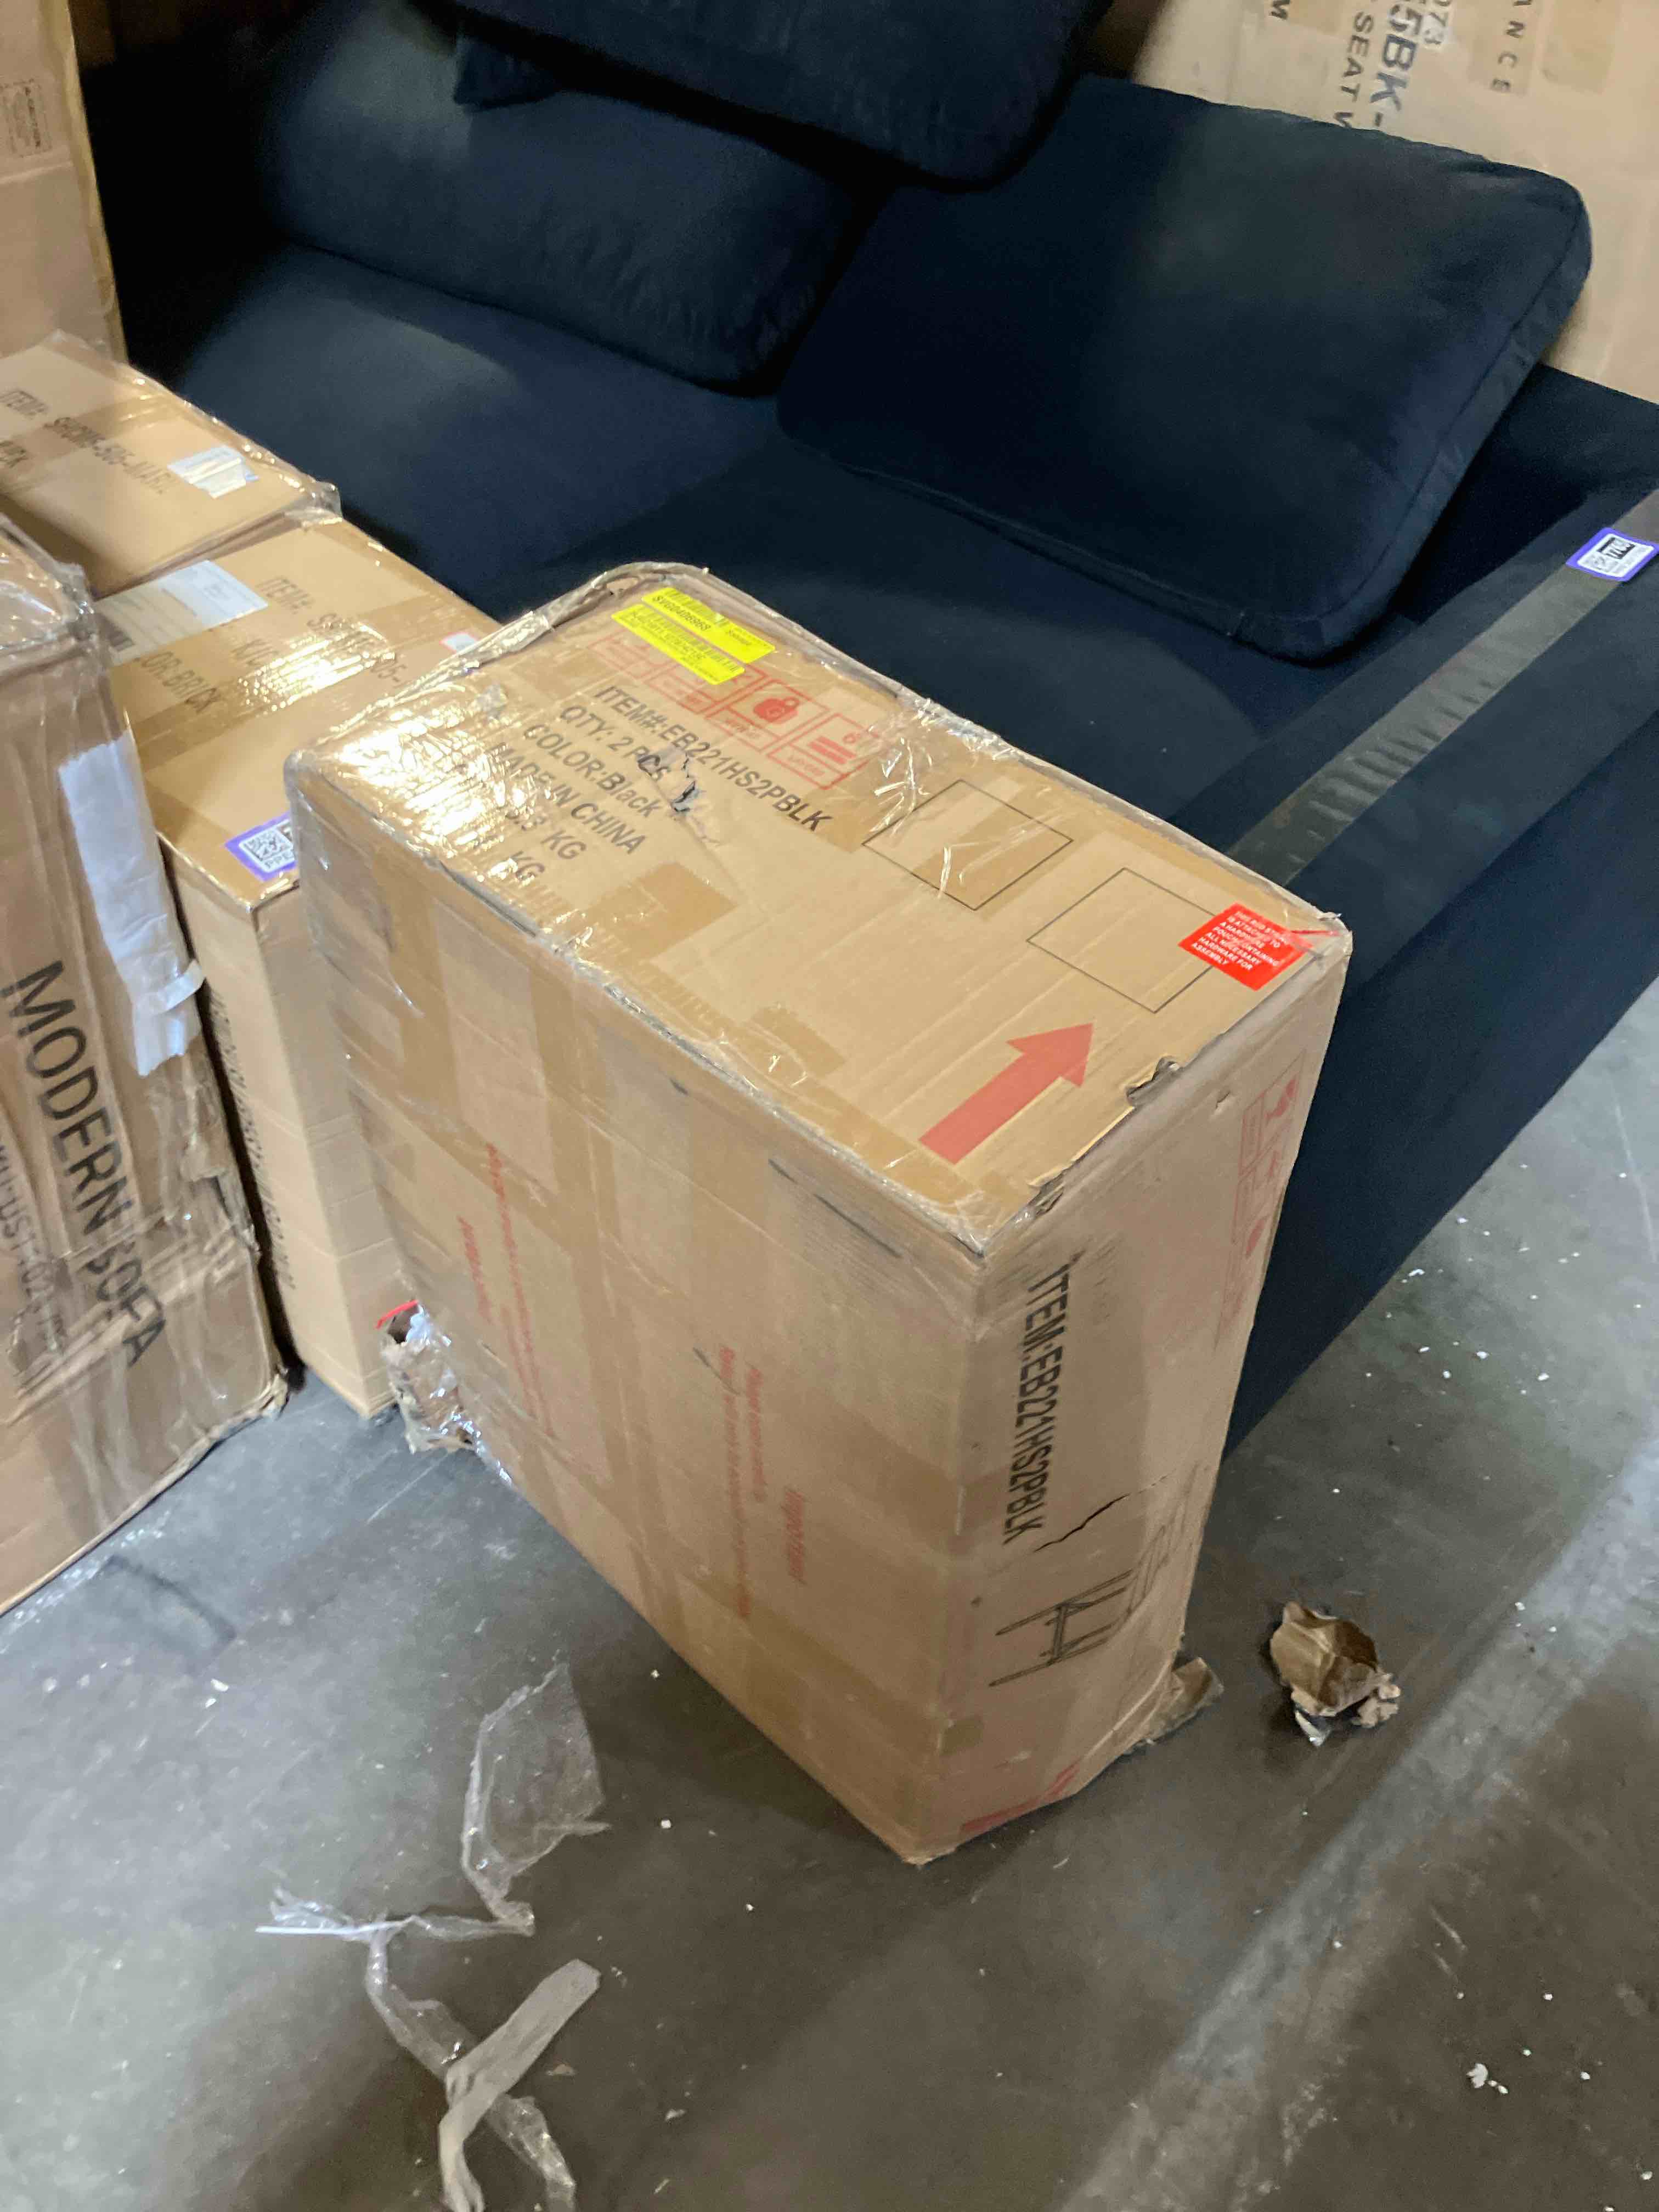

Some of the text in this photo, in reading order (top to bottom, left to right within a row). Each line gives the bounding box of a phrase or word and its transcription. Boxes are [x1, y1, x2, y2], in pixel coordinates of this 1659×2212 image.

[1423, 0, 1452, 46] 73
[1340, 10, 1375, 103] SEAT
[1368, 0, 1425, 128] 5BK-
[560, 705, 614, 742] QTY:
[607, 736, 634, 752] 2
[523, 723, 662, 818] COLOR:Black
[594, 686, 832, 831] ITEM#:EB221HS2PBLK
[541, 828, 587, 860] KG
[551, 783, 582, 808] IN
[571, 802, 646, 855] CHINA
[1189, 941, 1230, 966] ASSEMBLY
[1197, 936, 1255, 971] HARDWARE FOR
[1217, 939, 1263, 966] NESSARY
[1235, 940, 1282, 967] ONTAINING
[0, 960, 134, 1235] MODERN
[1003, 1262, 1071, 1545] ITEM:EB221HS2PBLK
